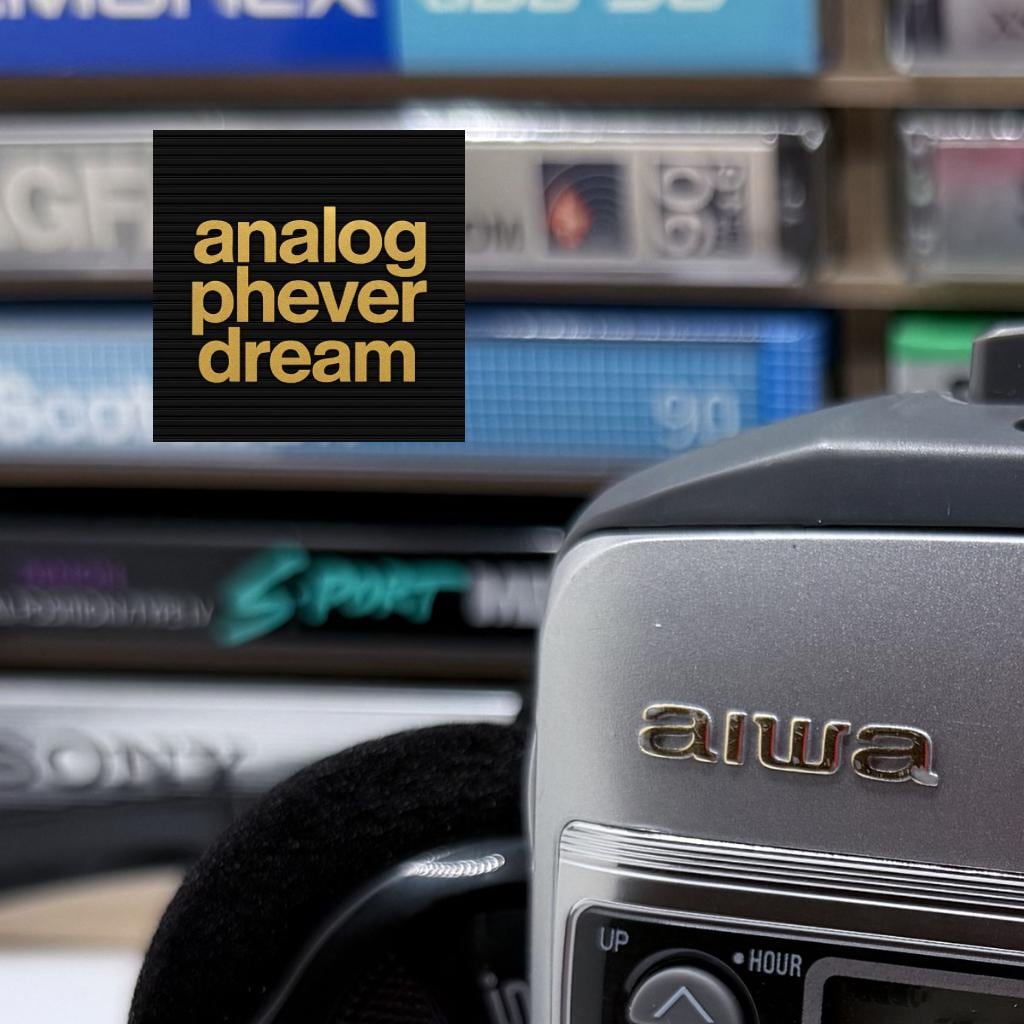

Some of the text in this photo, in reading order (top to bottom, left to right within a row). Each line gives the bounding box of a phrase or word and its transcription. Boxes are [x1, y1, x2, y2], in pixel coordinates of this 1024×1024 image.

[0, 164, 152, 252] GF
[0, 732, 246, 795] SONY
[638, 702, 940, 788] aiwa
[598, 927, 630, 953] UP
[748, 949, 803, 978] HOUR
